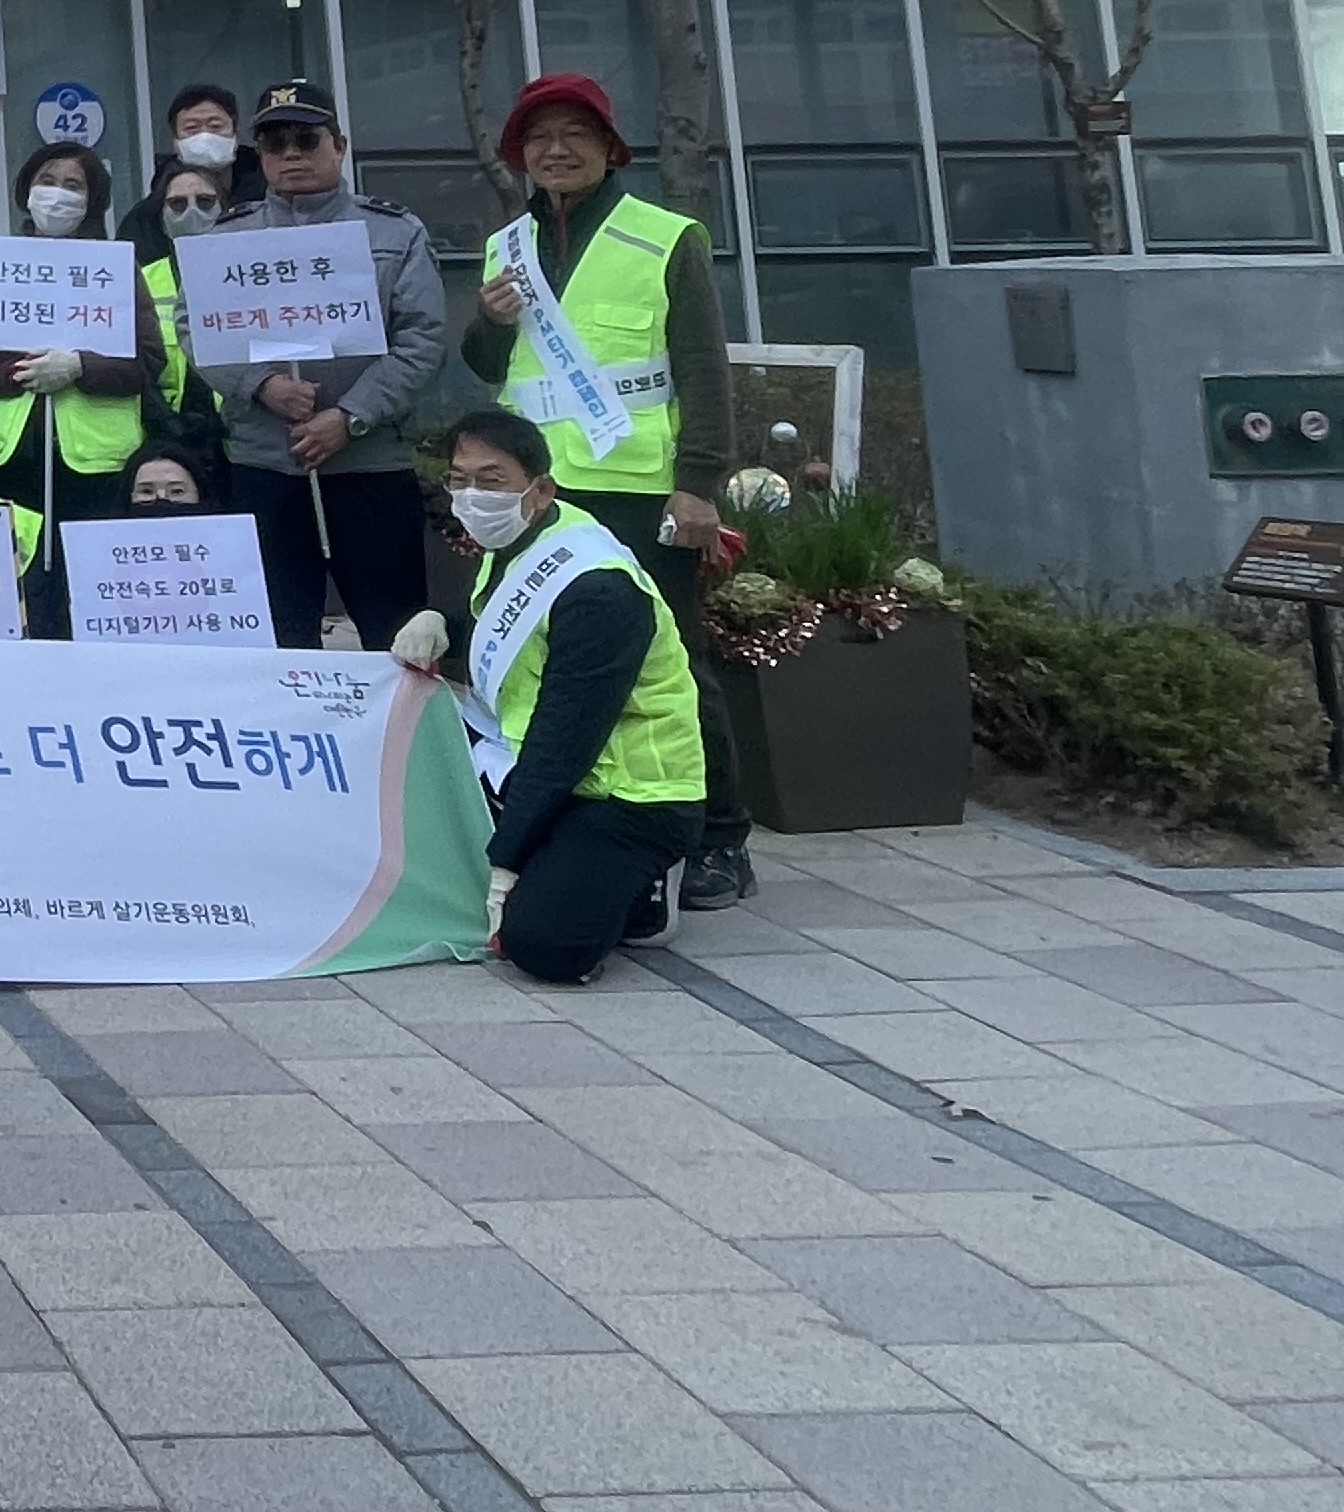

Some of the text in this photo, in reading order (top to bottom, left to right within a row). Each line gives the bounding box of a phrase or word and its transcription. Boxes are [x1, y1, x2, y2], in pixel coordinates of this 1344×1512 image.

[53, 112, 88, 133] 42
[67, 264, 115, 289] 필수
[223, 256, 335, 288] 사용한 후
[67, 304, 114, 329] 거치
[202, 300, 372, 331] 바르게 주차하기
[111, 541, 211, 565] 안전모 필수
[97, 577, 237, 601] 안전속도 20킬로
[85, 612, 260, 637] 디지털기기 사용 NO
[29, 722, 87, 785] 더
[99, 712, 351, 796] 안전하게
[46, 898, 106, 921] 바르게
[113, 900, 257, 929] 살기운동위원회,
